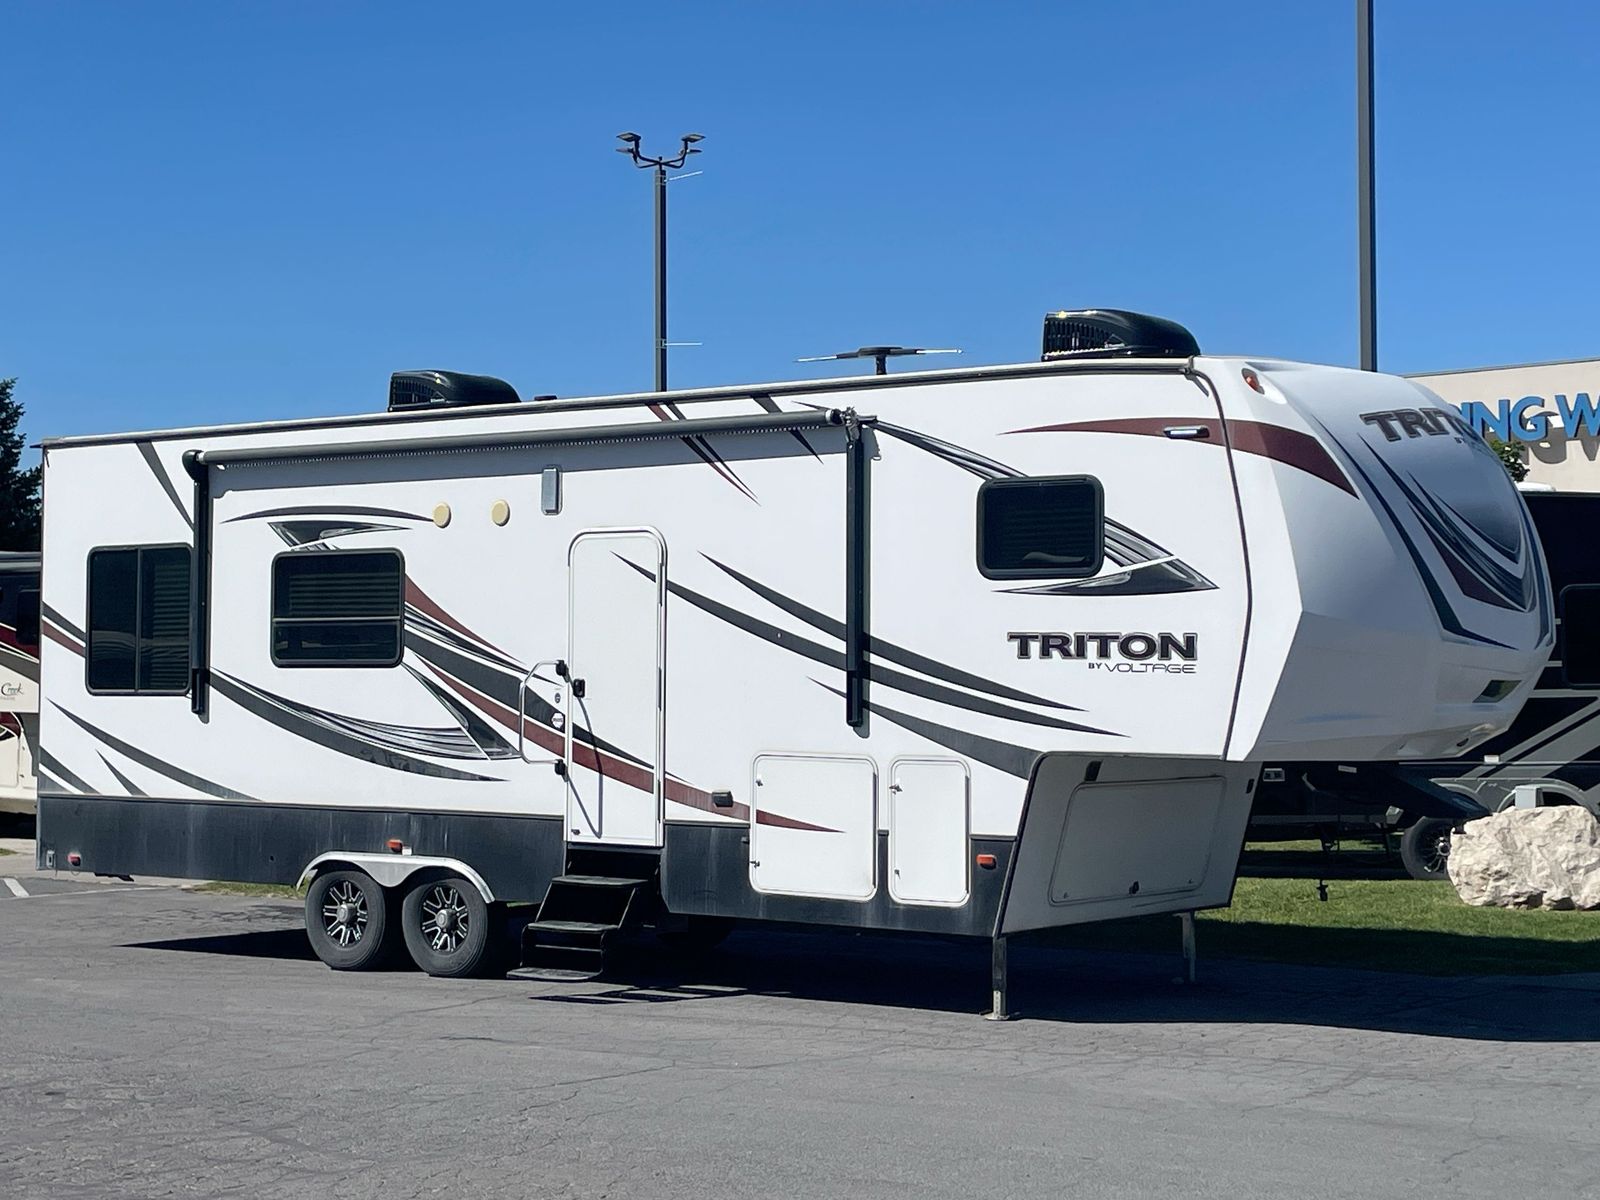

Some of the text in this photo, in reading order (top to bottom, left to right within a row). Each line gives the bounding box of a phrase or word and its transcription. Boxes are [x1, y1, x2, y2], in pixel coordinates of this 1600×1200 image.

[1450, 396, 1547, 442] ING
[1007, 631, 1198, 661] TRITON
[1104, 662, 1197, 674] VOLTAGE
